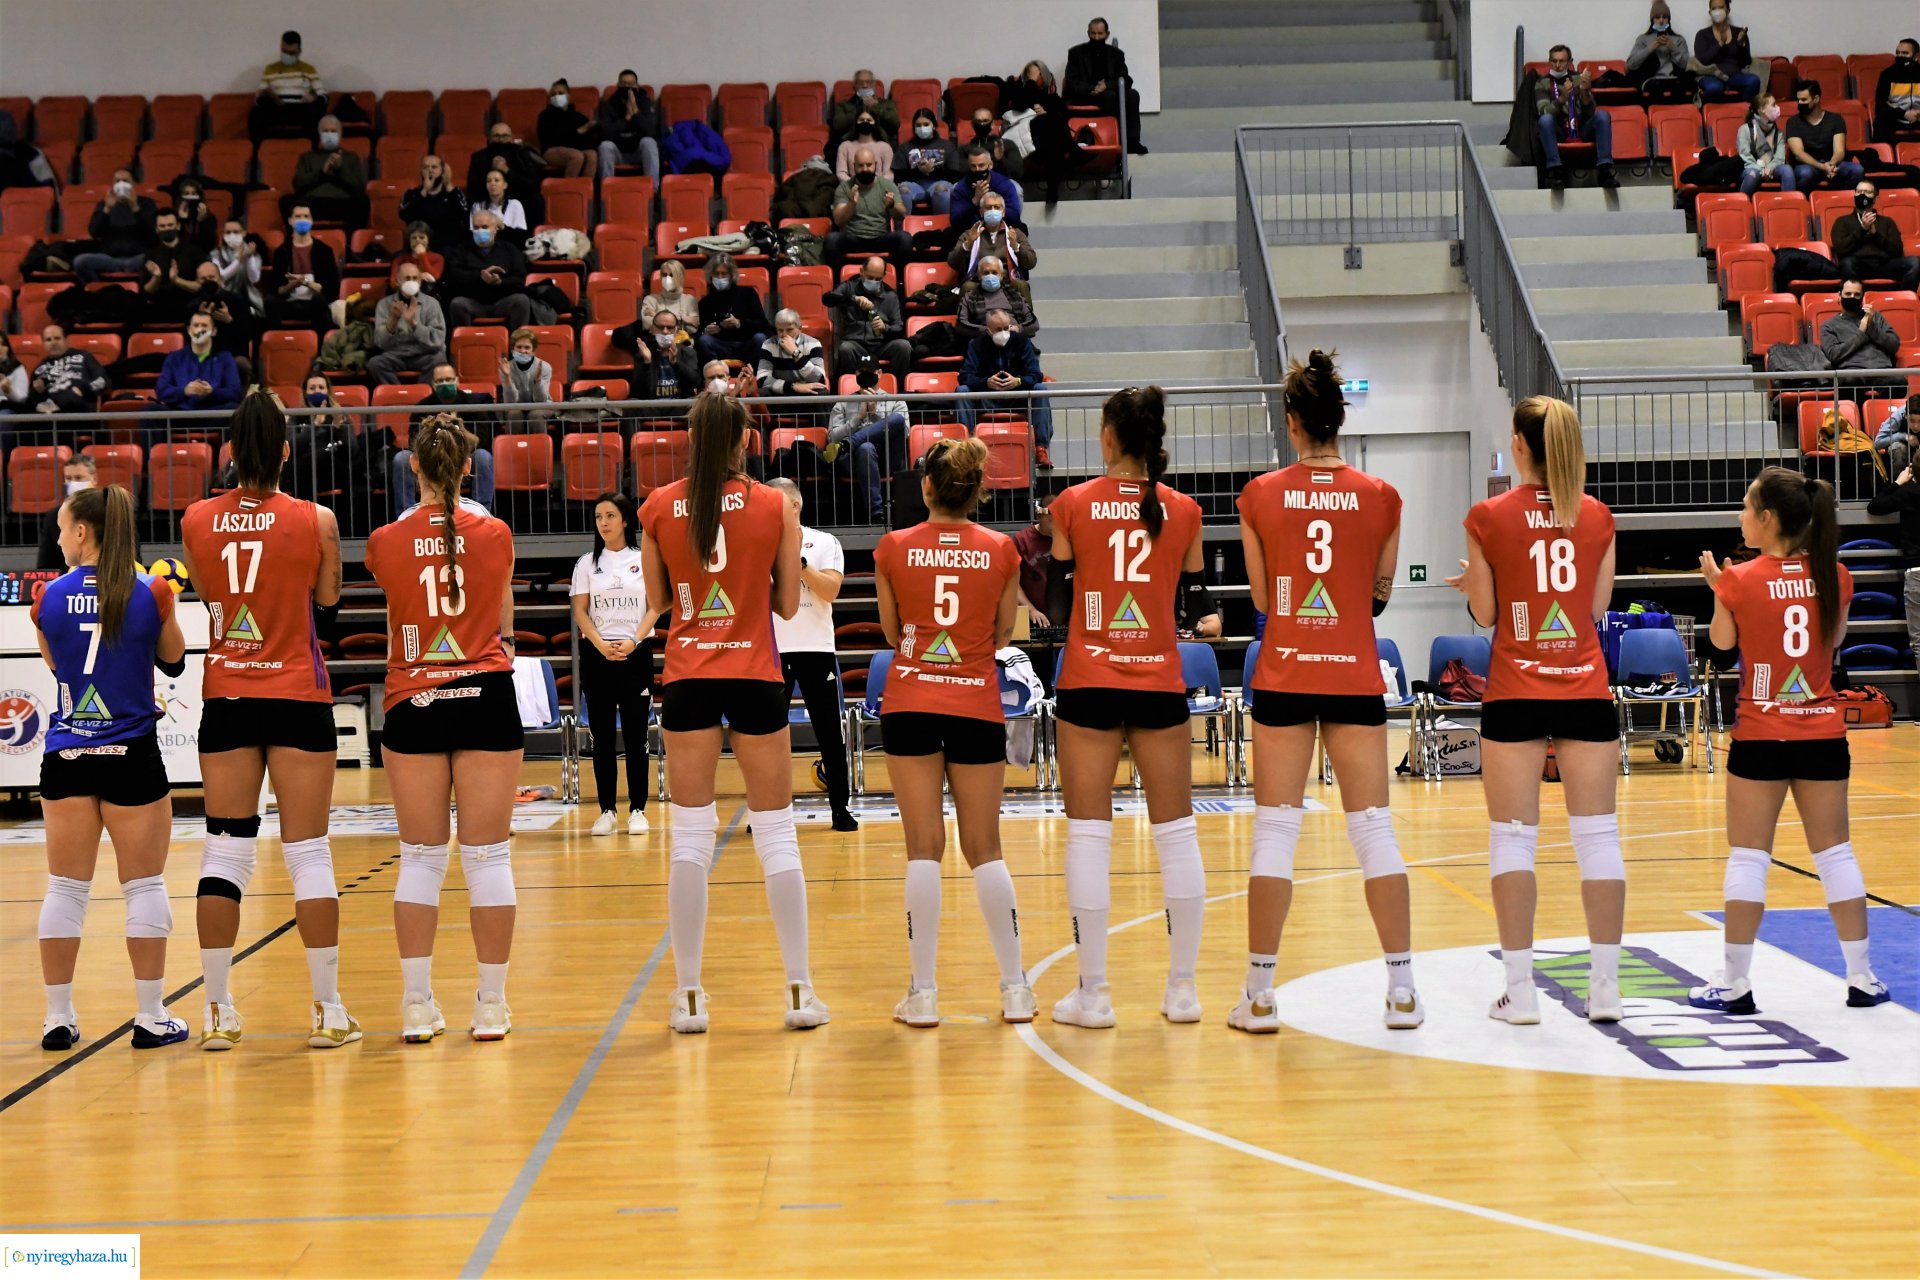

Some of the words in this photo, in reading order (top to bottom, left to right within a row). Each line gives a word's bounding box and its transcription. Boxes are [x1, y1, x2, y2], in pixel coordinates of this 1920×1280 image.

[1284, 490, 1359, 511] MILANOVA
[213, 512, 276, 533] LÁSZLOP
[1305, 520, 1333, 574] 3
[907, 549, 990, 570] FRANCESCO
[1108, 529, 1152, 582] 12
[221, 540, 263, 594] 17
[1529, 538, 1577, 593] 18
[419, 564, 466, 617] 13
[1767, 578, 1804, 600] TÓTH
[594, 594, 640, 610] FATUM
[933, 575, 960, 626] 5
[699, 620, 725, 628] KE-VIZ
[1297, 617, 1327, 625] KE-VIZ
[1328, 617, 1338, 625] 21
[1109, 631, 1138, 639] KE-VIZ
[1139, 631, 1149, 639] 21
[1783, 605, 1809, 657] 8
[79, 622, 103, 675] 7
[224, 640, 251, 650] KE-VIZ
[251, 642, 262, 650] 21
[408, 626, 416, 660] STRABAG
[697, 641, 752, 650] BESTRONG
[1536, 641, 1567, 650] KE-VIZ
[224, 660, 283, 669] BESTRONG
[1108, 654, 1165, 663] BESTRONG
[1297, 654, 1357, 663] BESTRONG
[1538, 665, 1595, 675] BESTRONG
[918, 674, 985, 687] BESTRONG
[1779, 706, 1836, 715] BESTRONG
[72, 720, 100, 728] KE-VIZ
